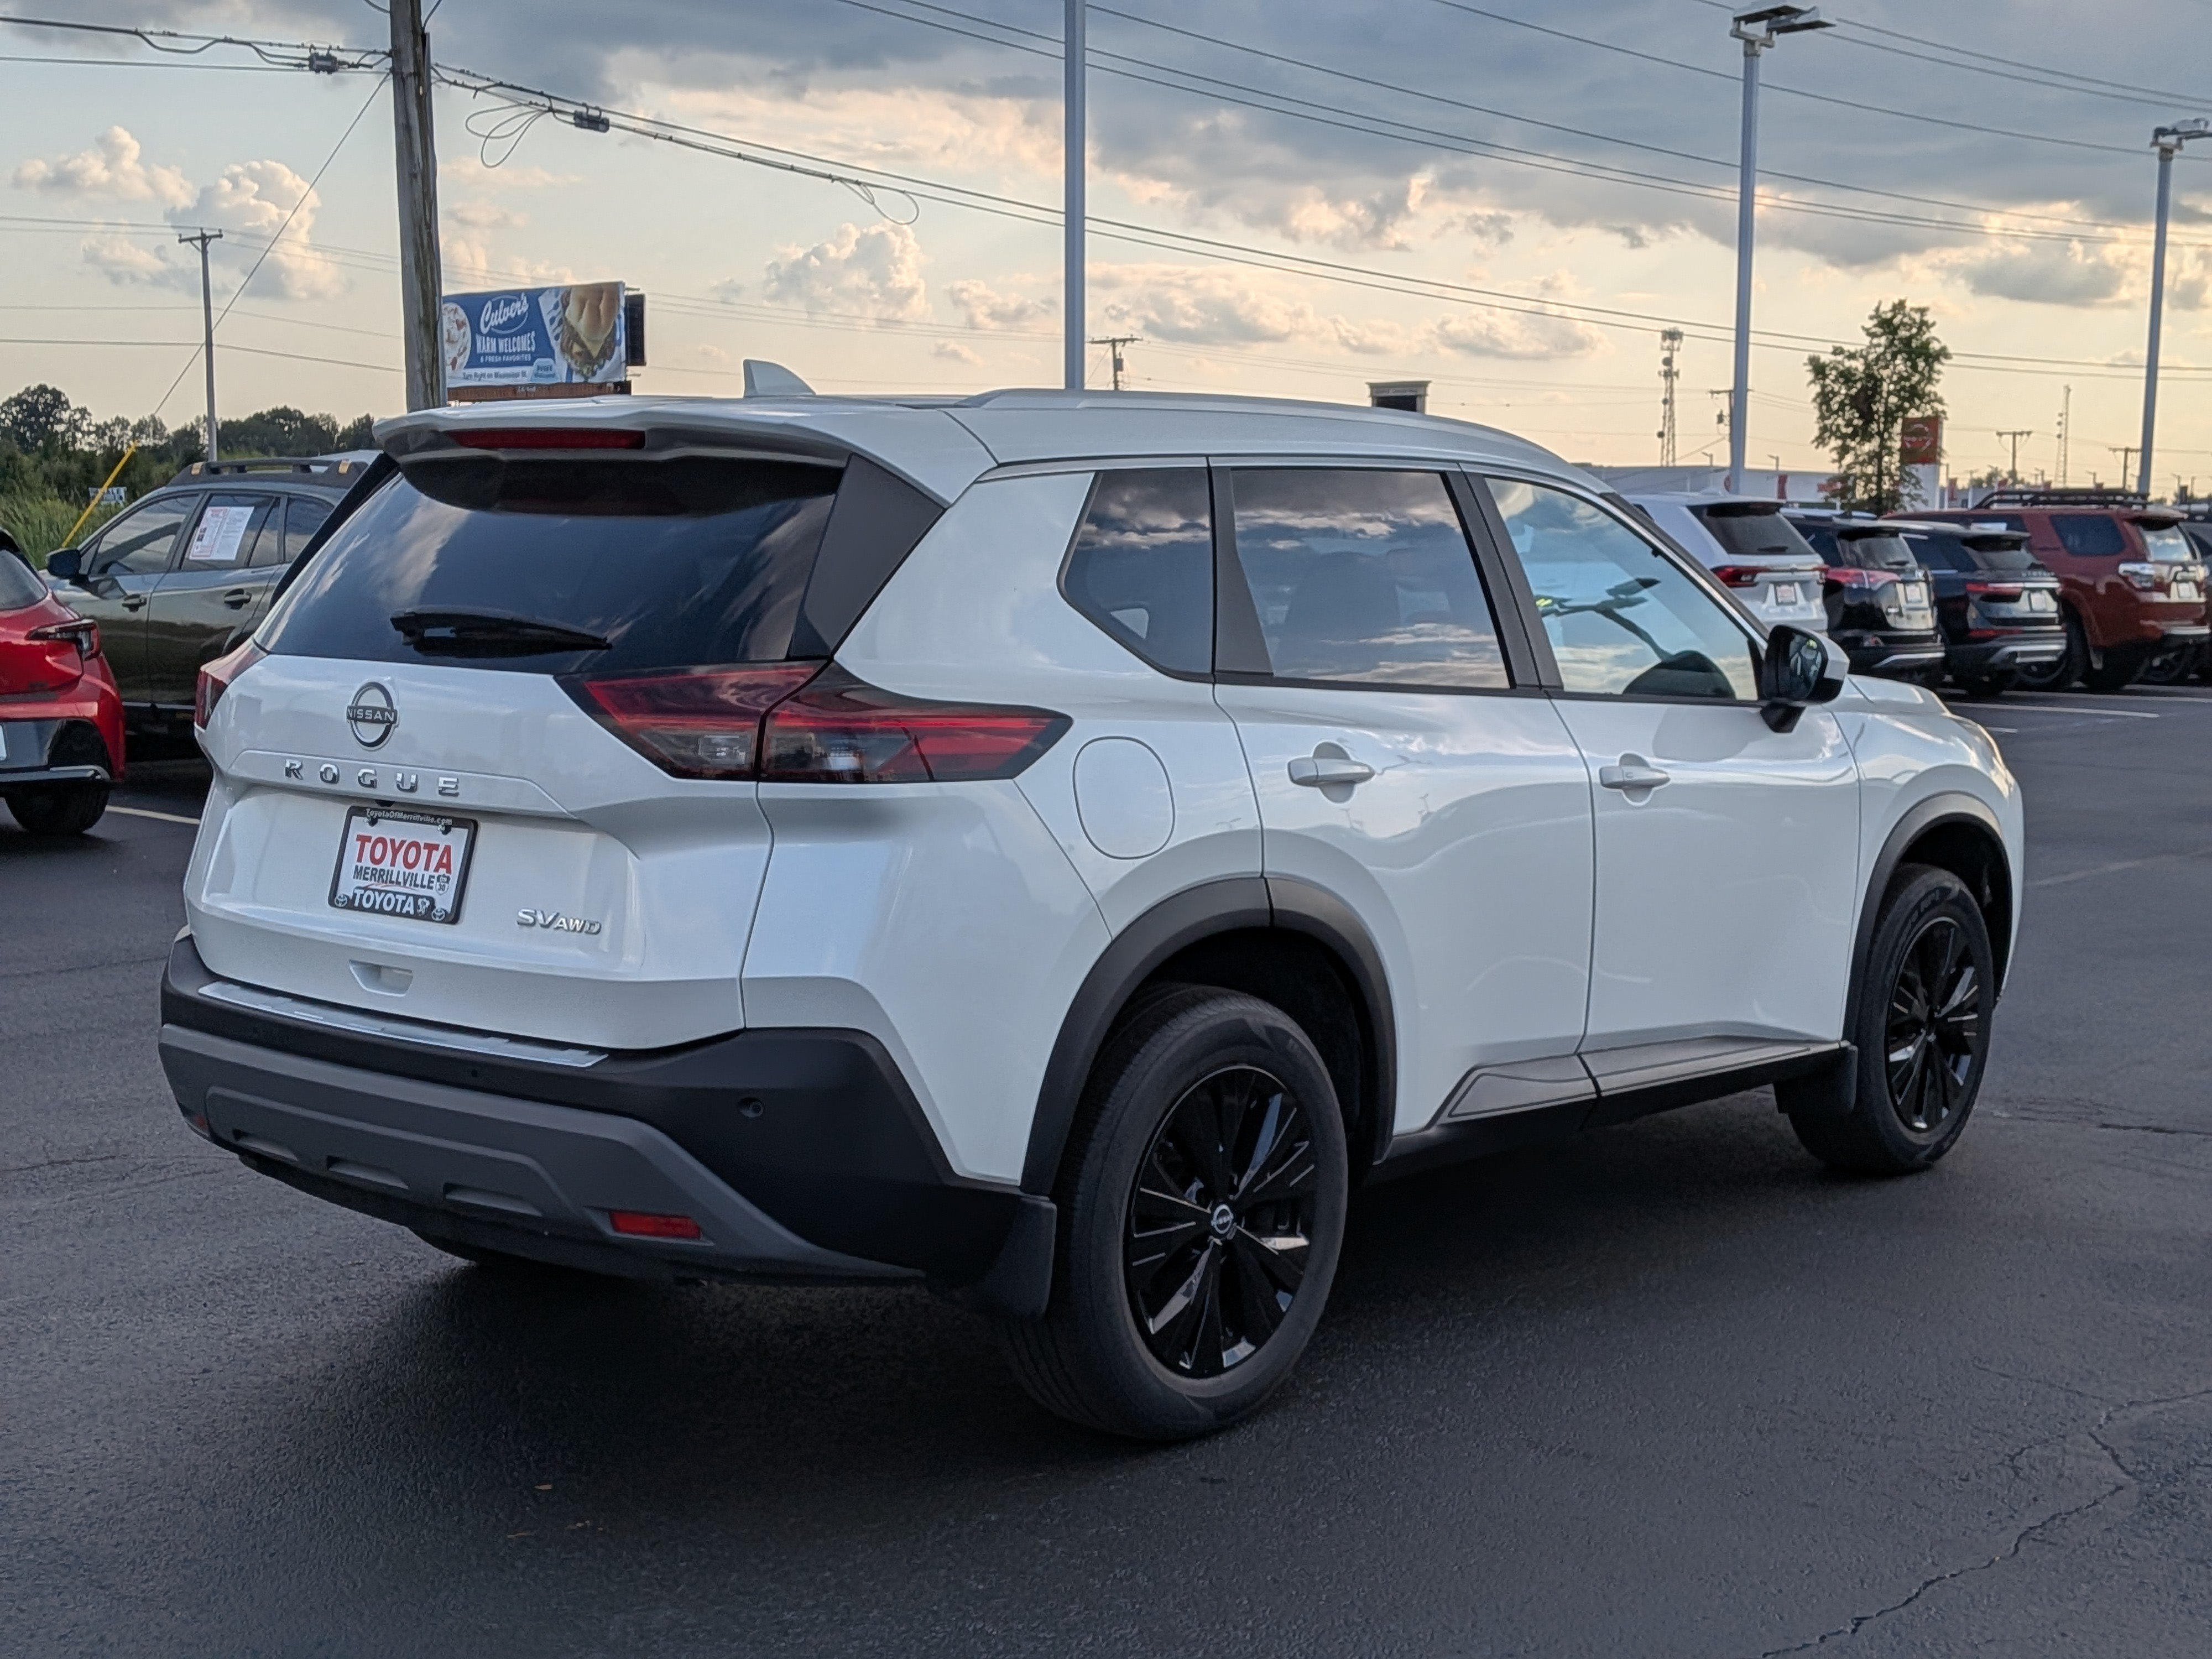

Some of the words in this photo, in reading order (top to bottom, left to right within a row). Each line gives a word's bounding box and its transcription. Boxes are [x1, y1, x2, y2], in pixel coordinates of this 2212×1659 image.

[480, 292, 529, 334] Culver's
[476, 333, 496, 354] WARM
[498, 331, 535, 353] WELCOMES
[348, 707, 394, 722] NISSAN
[285, 759, 460, 797] ROGUE
[356, 834, 452, 874] TOYOTA
[353, 865, 435, 890] MERRILLVILLE
[353, 889, 415, 915] TOYOTA
